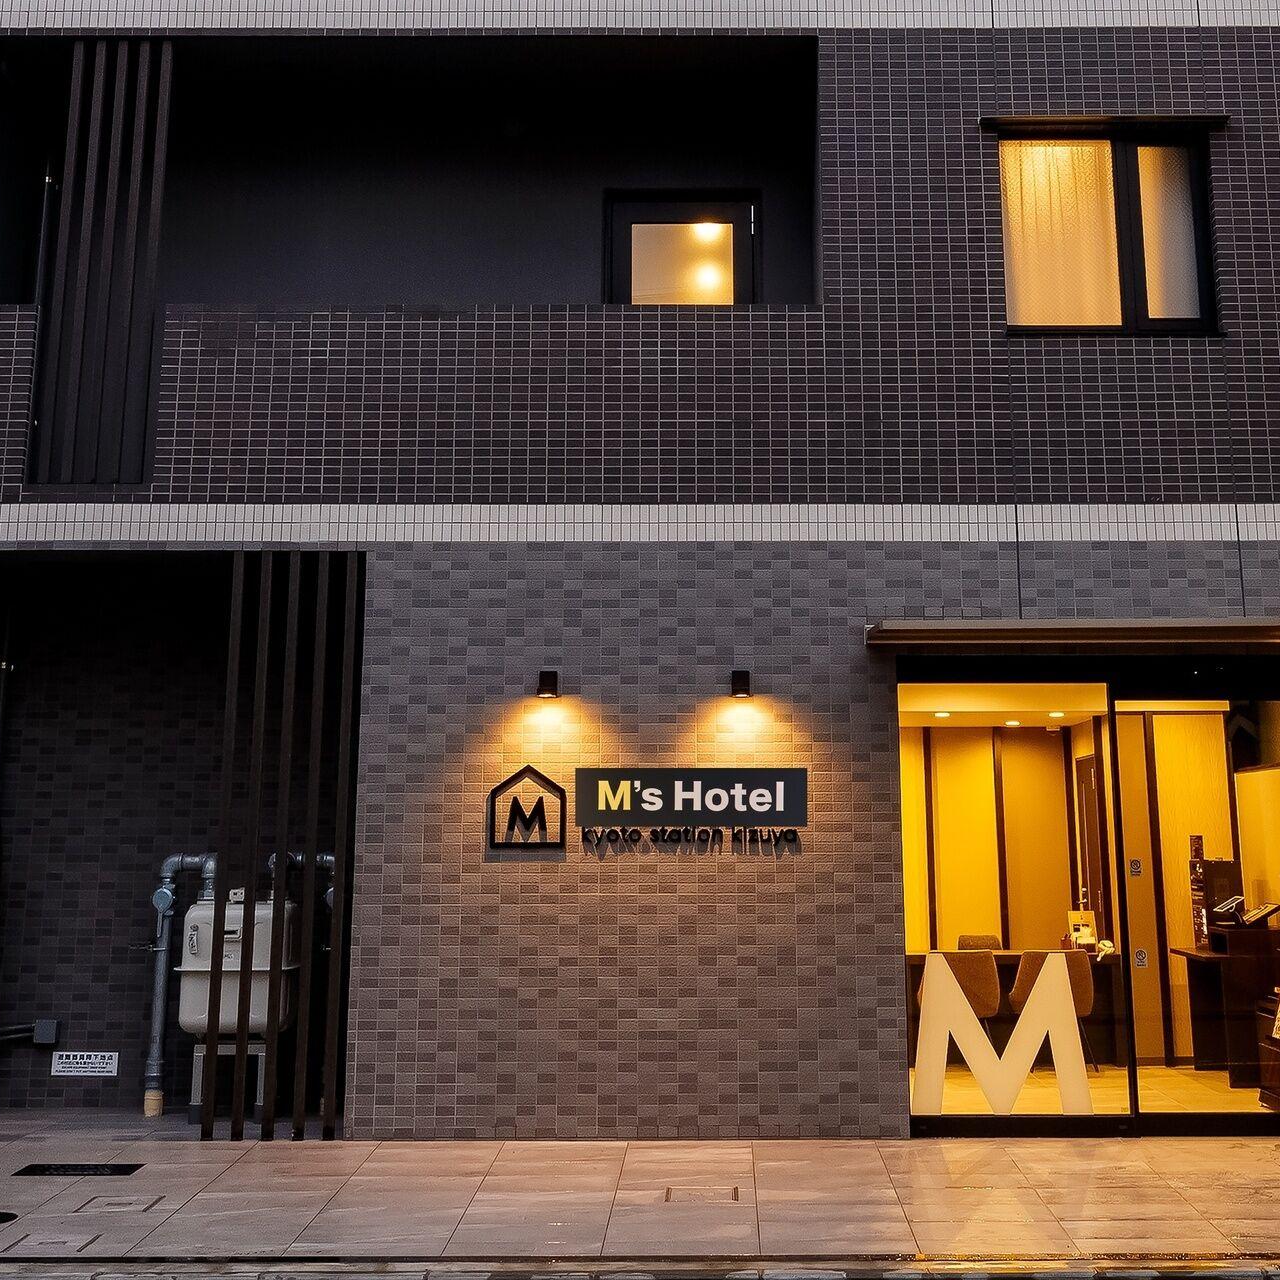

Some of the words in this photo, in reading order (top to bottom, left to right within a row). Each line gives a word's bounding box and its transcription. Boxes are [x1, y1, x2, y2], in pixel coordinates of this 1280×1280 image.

[597, 780, 663, 811] M's
[674, 780, 785, 812] Hotel
[506, 796, 547, 835] M
[582, 826, 643, 847] kyoto
[650, 826, 724, 843] station
[732, 826, 798, 847] kizuya
[911, 953, 1095, 1115] M
